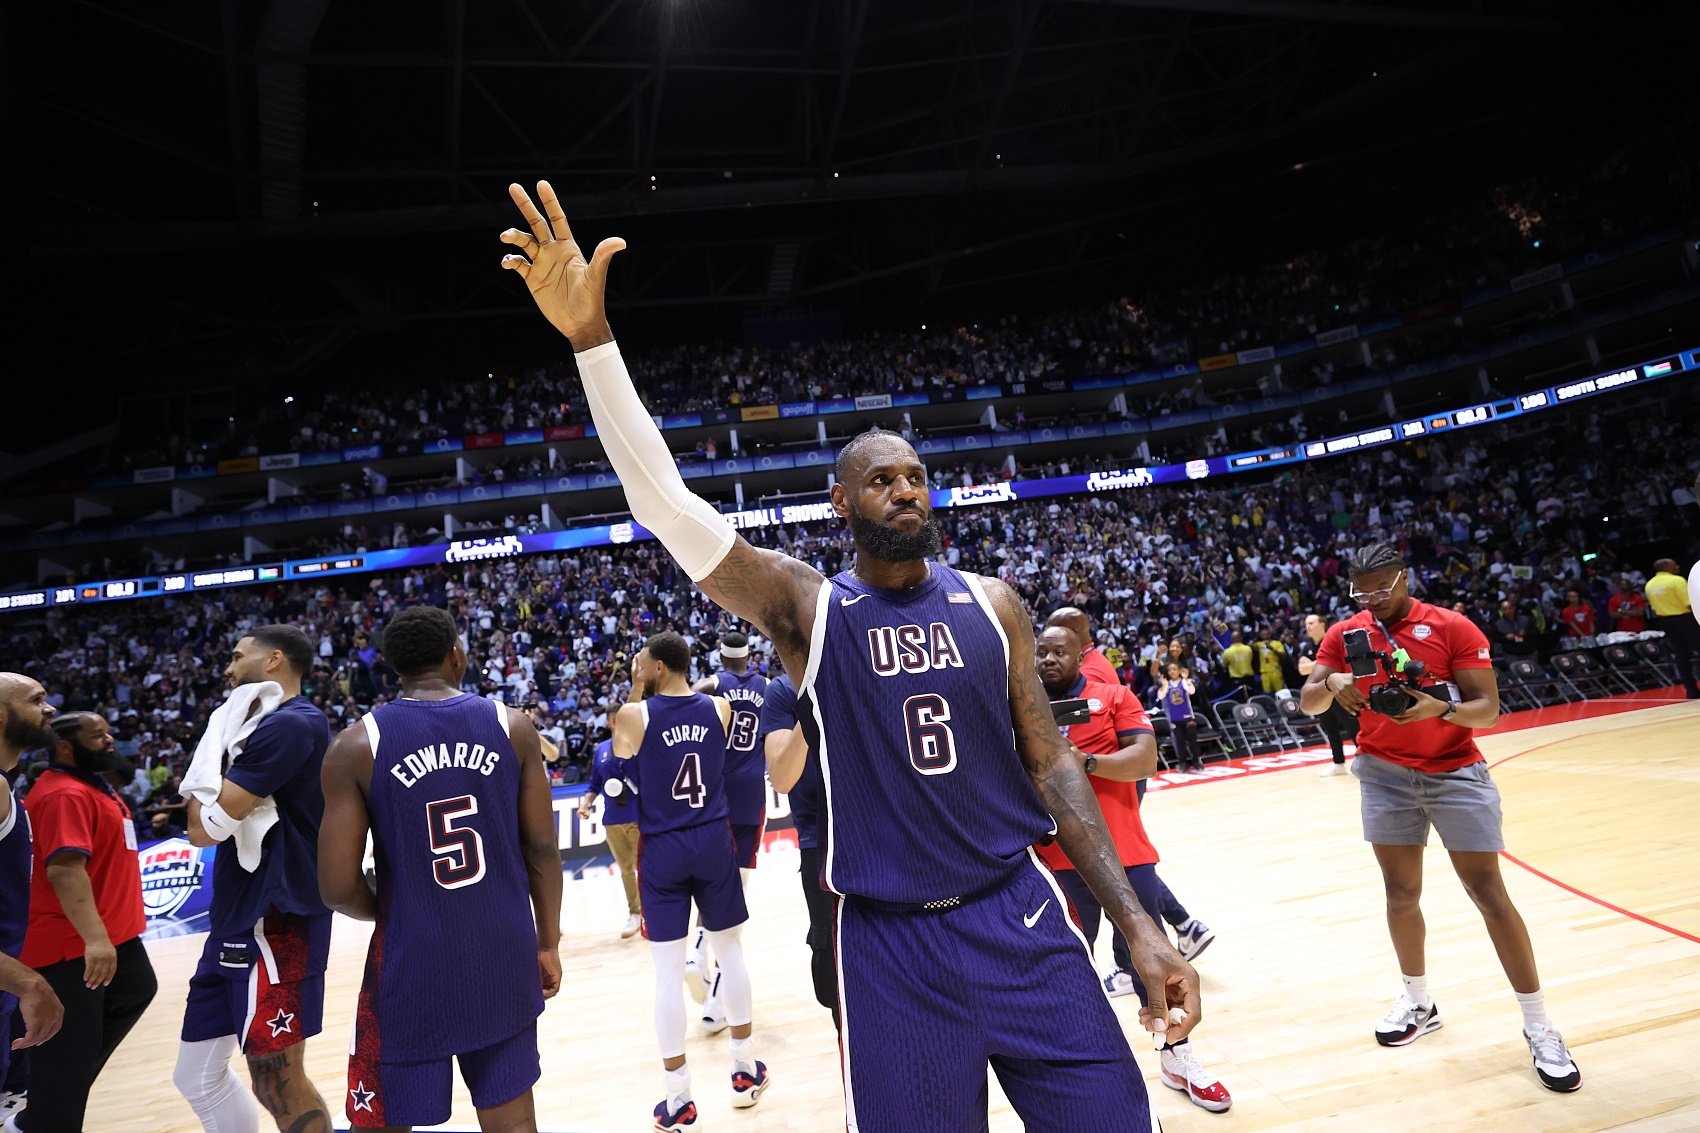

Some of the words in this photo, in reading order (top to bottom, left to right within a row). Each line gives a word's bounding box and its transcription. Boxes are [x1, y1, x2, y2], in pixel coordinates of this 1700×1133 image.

[1558, 380, 1595, 399] SOUTH
[1596, 369, 1637, 389] SUDAN
[782, 402, 814, 416] gopuff
[1520, 393, 1547, 409] 100
[1403, 421, 1425, 436] 101
[265, 457, 294, 467] Jeep
[781, 502, 842, 524] SHOWC
[867, 622, 965, 677] USA
[723, 688, 764, 708] ADEBAYO
[661, 724, 709, 747] CURRY
[903, 693, 958, 776] 6
[390, 742, 500, 789] EDWARDS
[671, 752, 707, 809] 4
[426, 794, 486, 890] 5
